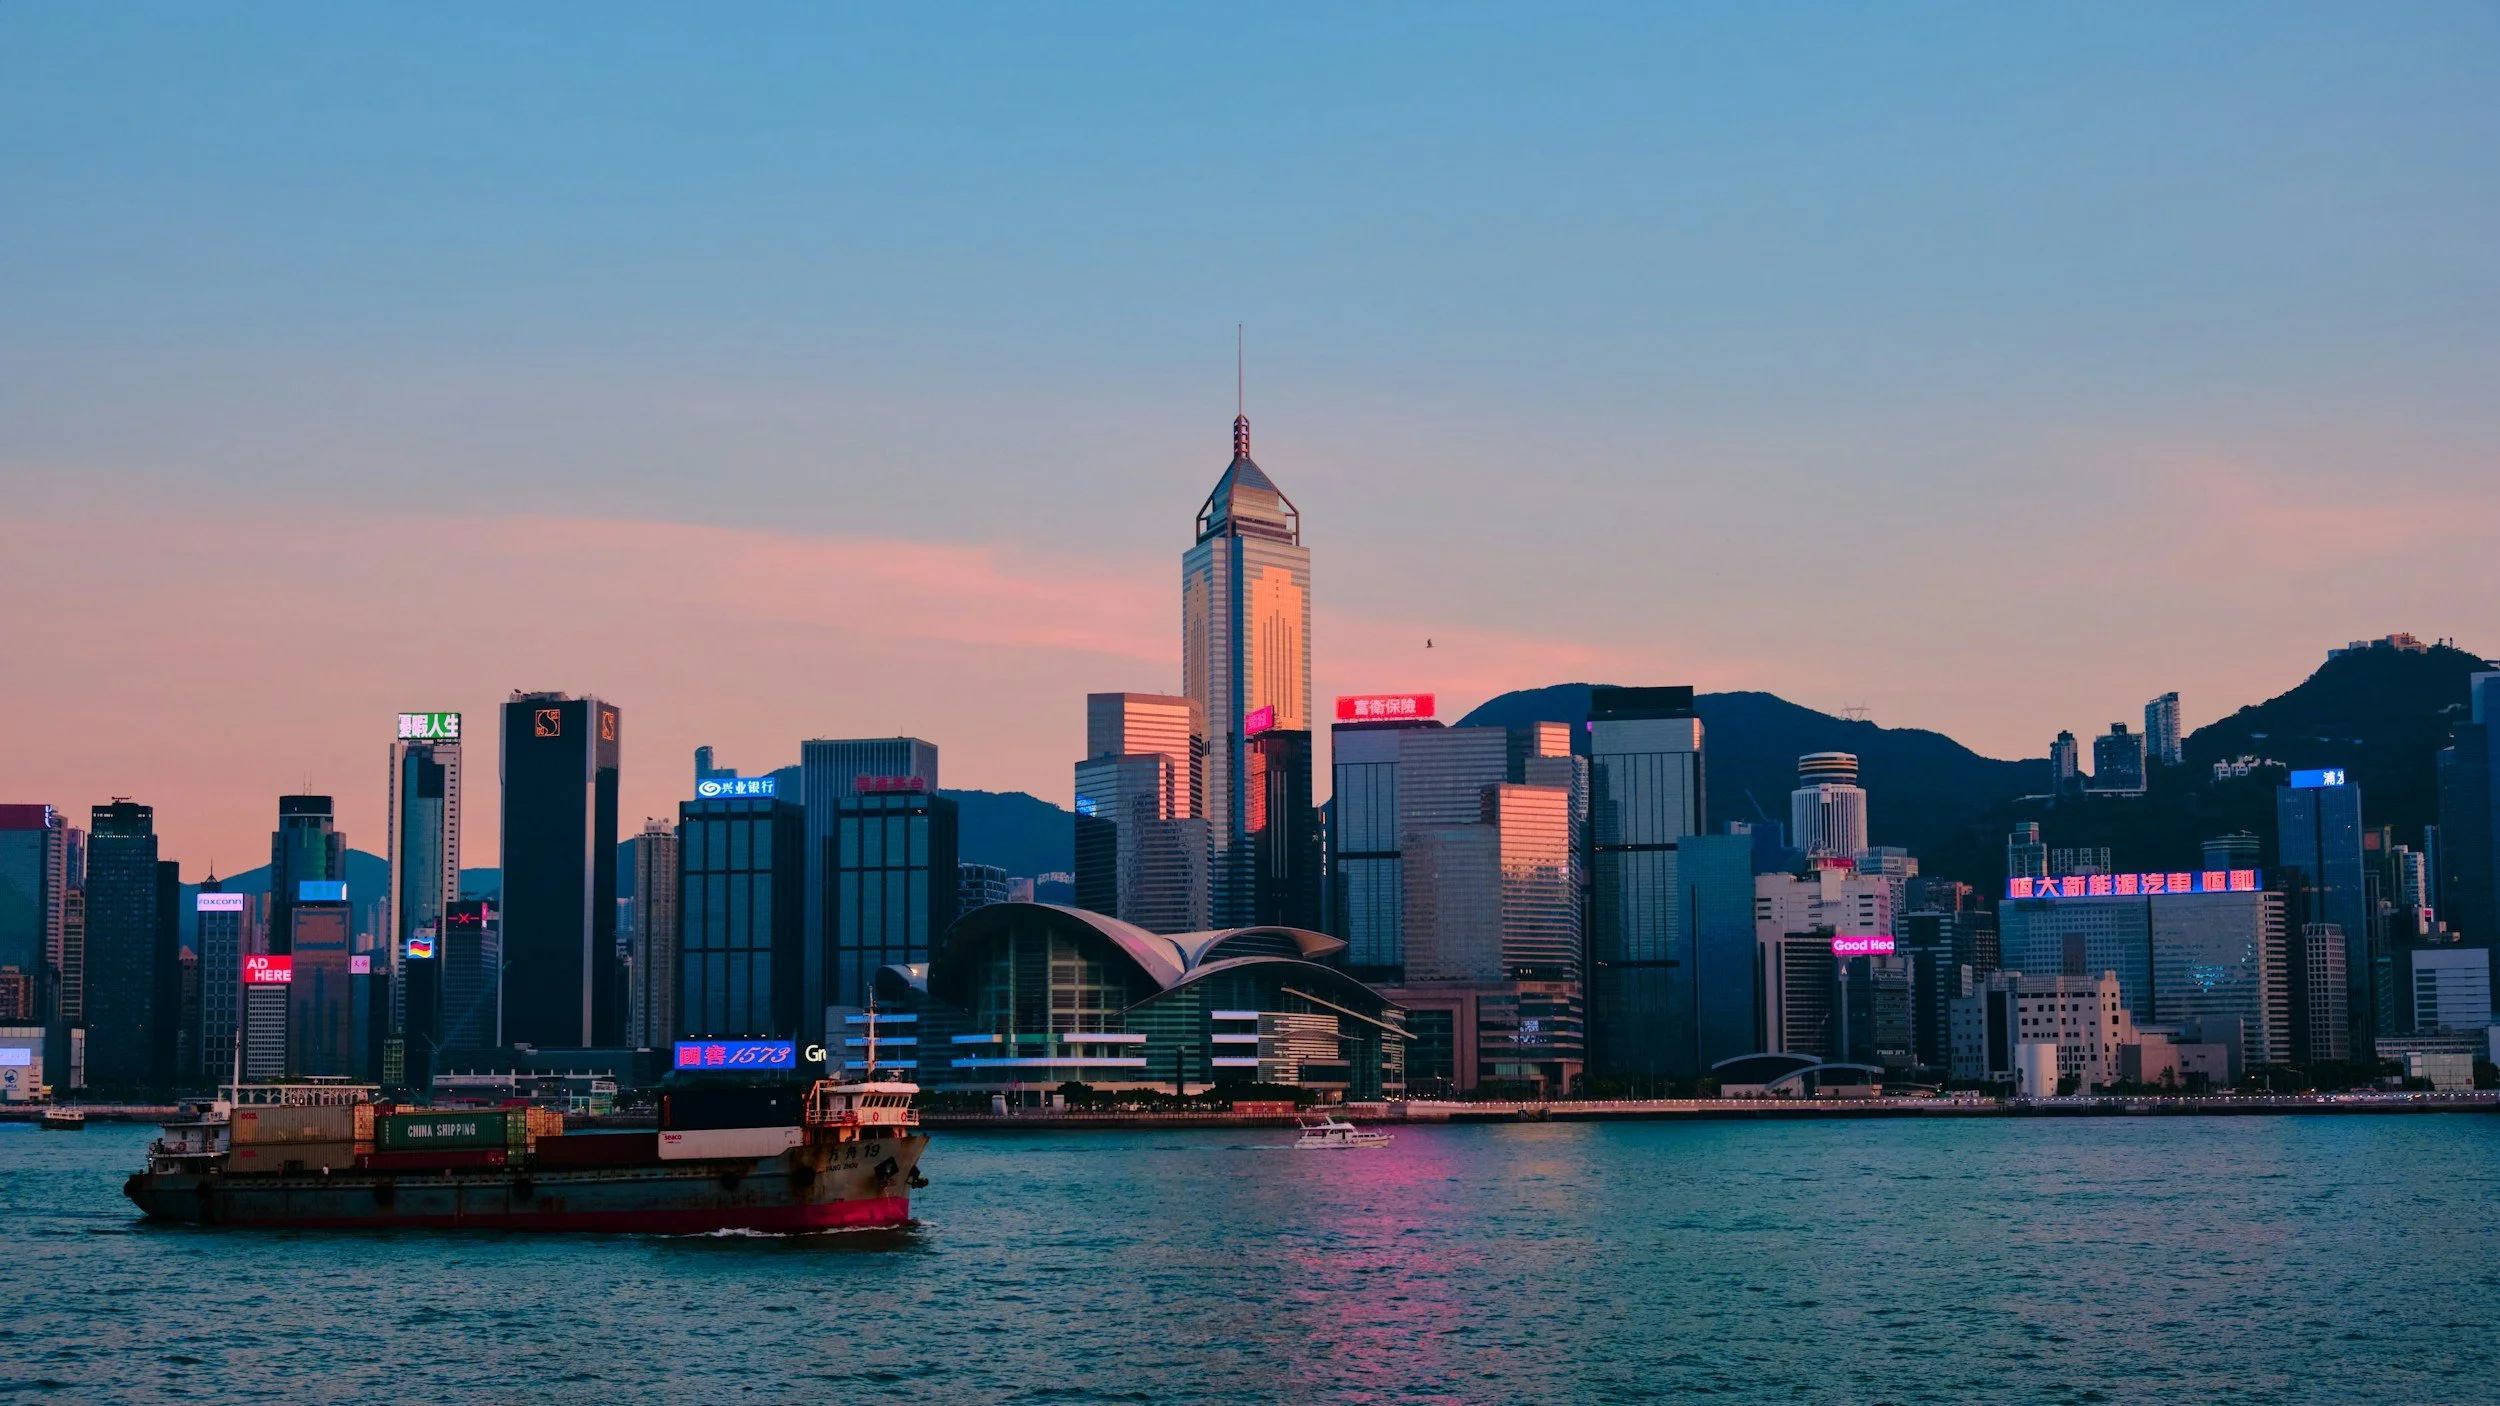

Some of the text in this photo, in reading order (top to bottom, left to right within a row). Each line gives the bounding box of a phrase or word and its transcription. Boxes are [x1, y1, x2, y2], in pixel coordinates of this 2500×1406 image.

[1354, 698, 1417, 715] 富衛保險
[721, 781, 774, 795] 兴业银行
[1833, 939, 1868, 951] Good
[247, 958, 268, 970] AD
[255, 970, 292, 982] HERE
[407, 1123, 432, 1138] CHINA
[436, 1122, 476, 1137] SHIPPING
[863, 1144, 881, 1158] 19
